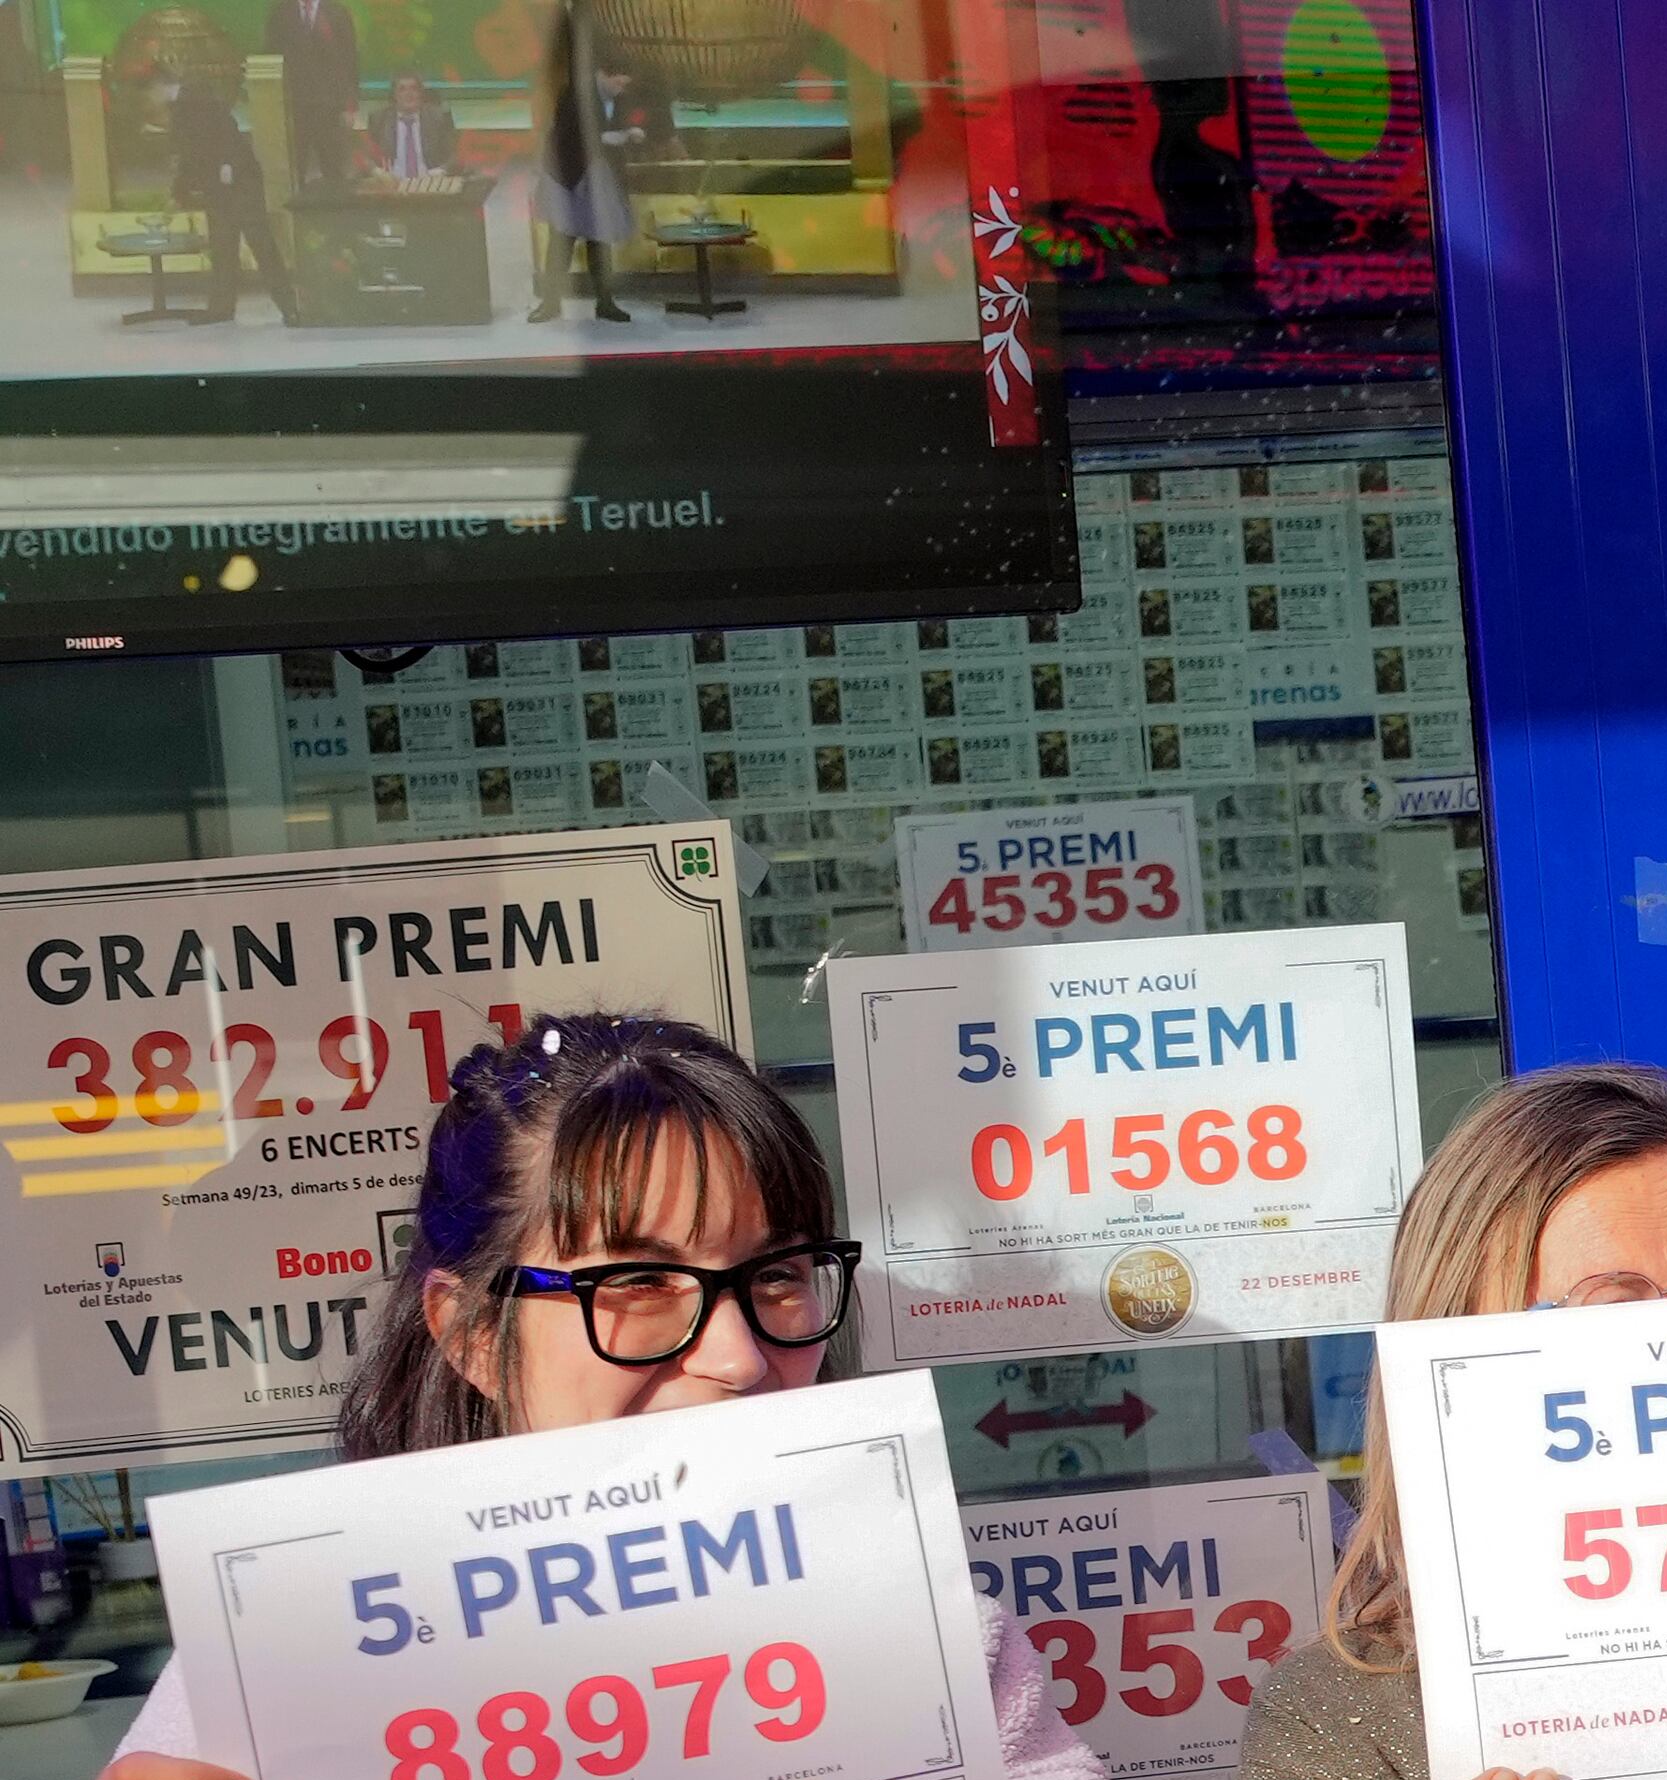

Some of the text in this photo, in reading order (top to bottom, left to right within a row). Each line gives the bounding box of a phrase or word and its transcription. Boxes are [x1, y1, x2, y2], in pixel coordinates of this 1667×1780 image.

[572, 491, 725, 534] Teruel.
[65, 635, 124, 650] PHILIPS
[928, 862, 1181, 935] 45353
[26, 898, 601, 1005] GRAN PREMI
[1049, 968, 1196, 998] VENUT AQUÍ
[957, 1002, 1297, 1083] 5è PREMI
[261, 1126, 420, 1163] 6 ENCERTS
[965, 1105, 1307, 1204] 01568
[162, 1189, 228, 1206] Setmana
[233, 1183, 283, 1202] 49/23,
[291, 1178, 349, 1196] dimarts
[353, 1176, 362, 1191] 5
[366, 1174, 385, 1189] de
[1106, 1211, 1185, 1225] Lotería Nacional
[1253, 1203, 1311, 1213] BARCELONA
[999, 1216, 1288, 1247] NO HI HA SORT MÉS GRAN QUE LA DE TENIR-NOS
[276, 1247, 372, 1279] Bono
[44, 1273, 184, 1296] Loterías y Apuestas
[1241, 1270, 1361, 1290] 22 DESEMBRE
[79, 1291, 153, 1309] del Estado
[910, 1293, 1067, 1317] LOTERIA de NADAL
[104, 1296, 368, 1376] VENUT
[1544, 1390, 1612, 1463] 5è
[466, 1473, 662, 1532] VENUT AQUÍ
[968, 1508, 1118, 1542] VENUT AQUÍ
[351, 1503, 804, 1657] 5è PREMI
[1502, 1716, 1586, 1738] LOTERIA
[1590, 1714, 1609, 1730] de
[1179, 1738, 1238, 1751] BARCELONA
[1110, 1753, 1216, 1774] LA DE TENIR-NOS
